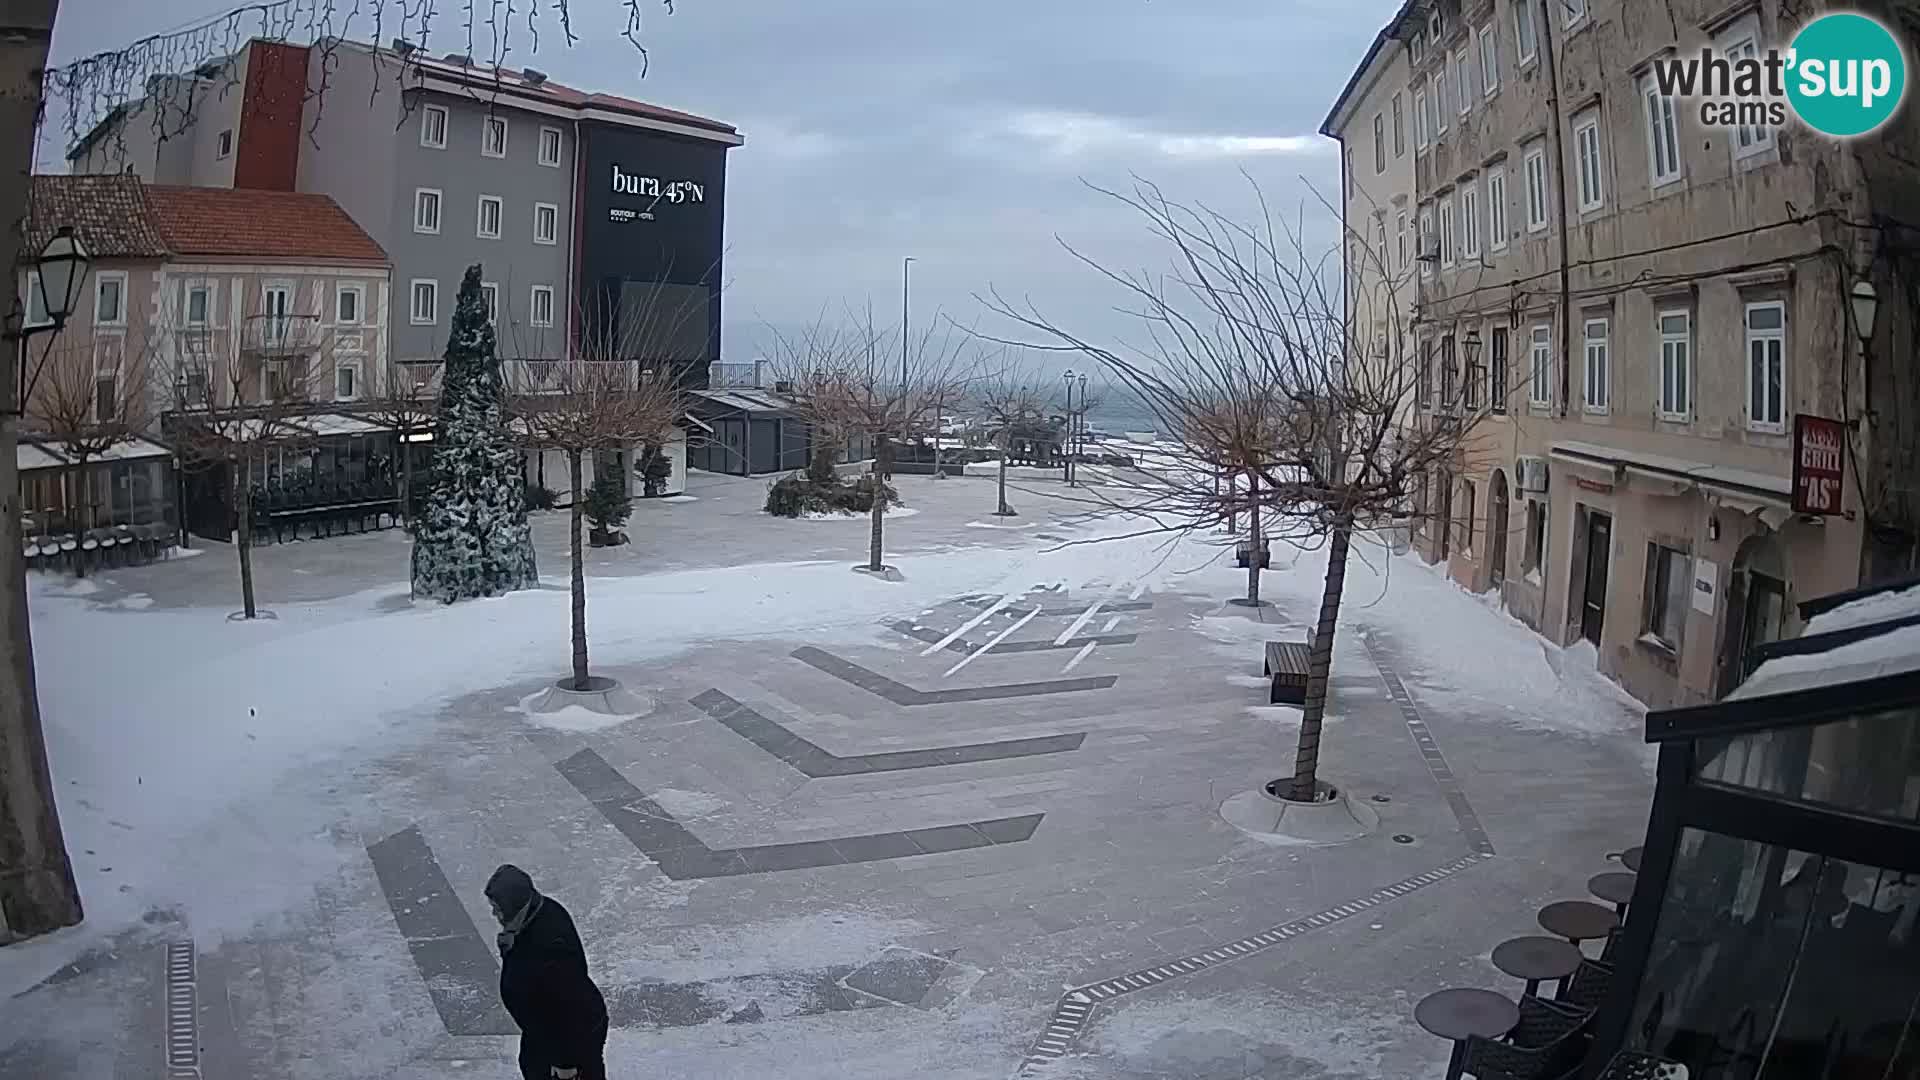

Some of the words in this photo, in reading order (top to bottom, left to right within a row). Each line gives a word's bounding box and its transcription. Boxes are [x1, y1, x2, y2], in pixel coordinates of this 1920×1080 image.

[612, 165, 660, 197] bura
[610, 209, 636, 218] BOUTIQUE
[1801, 447, 1841, 471] GRILL
